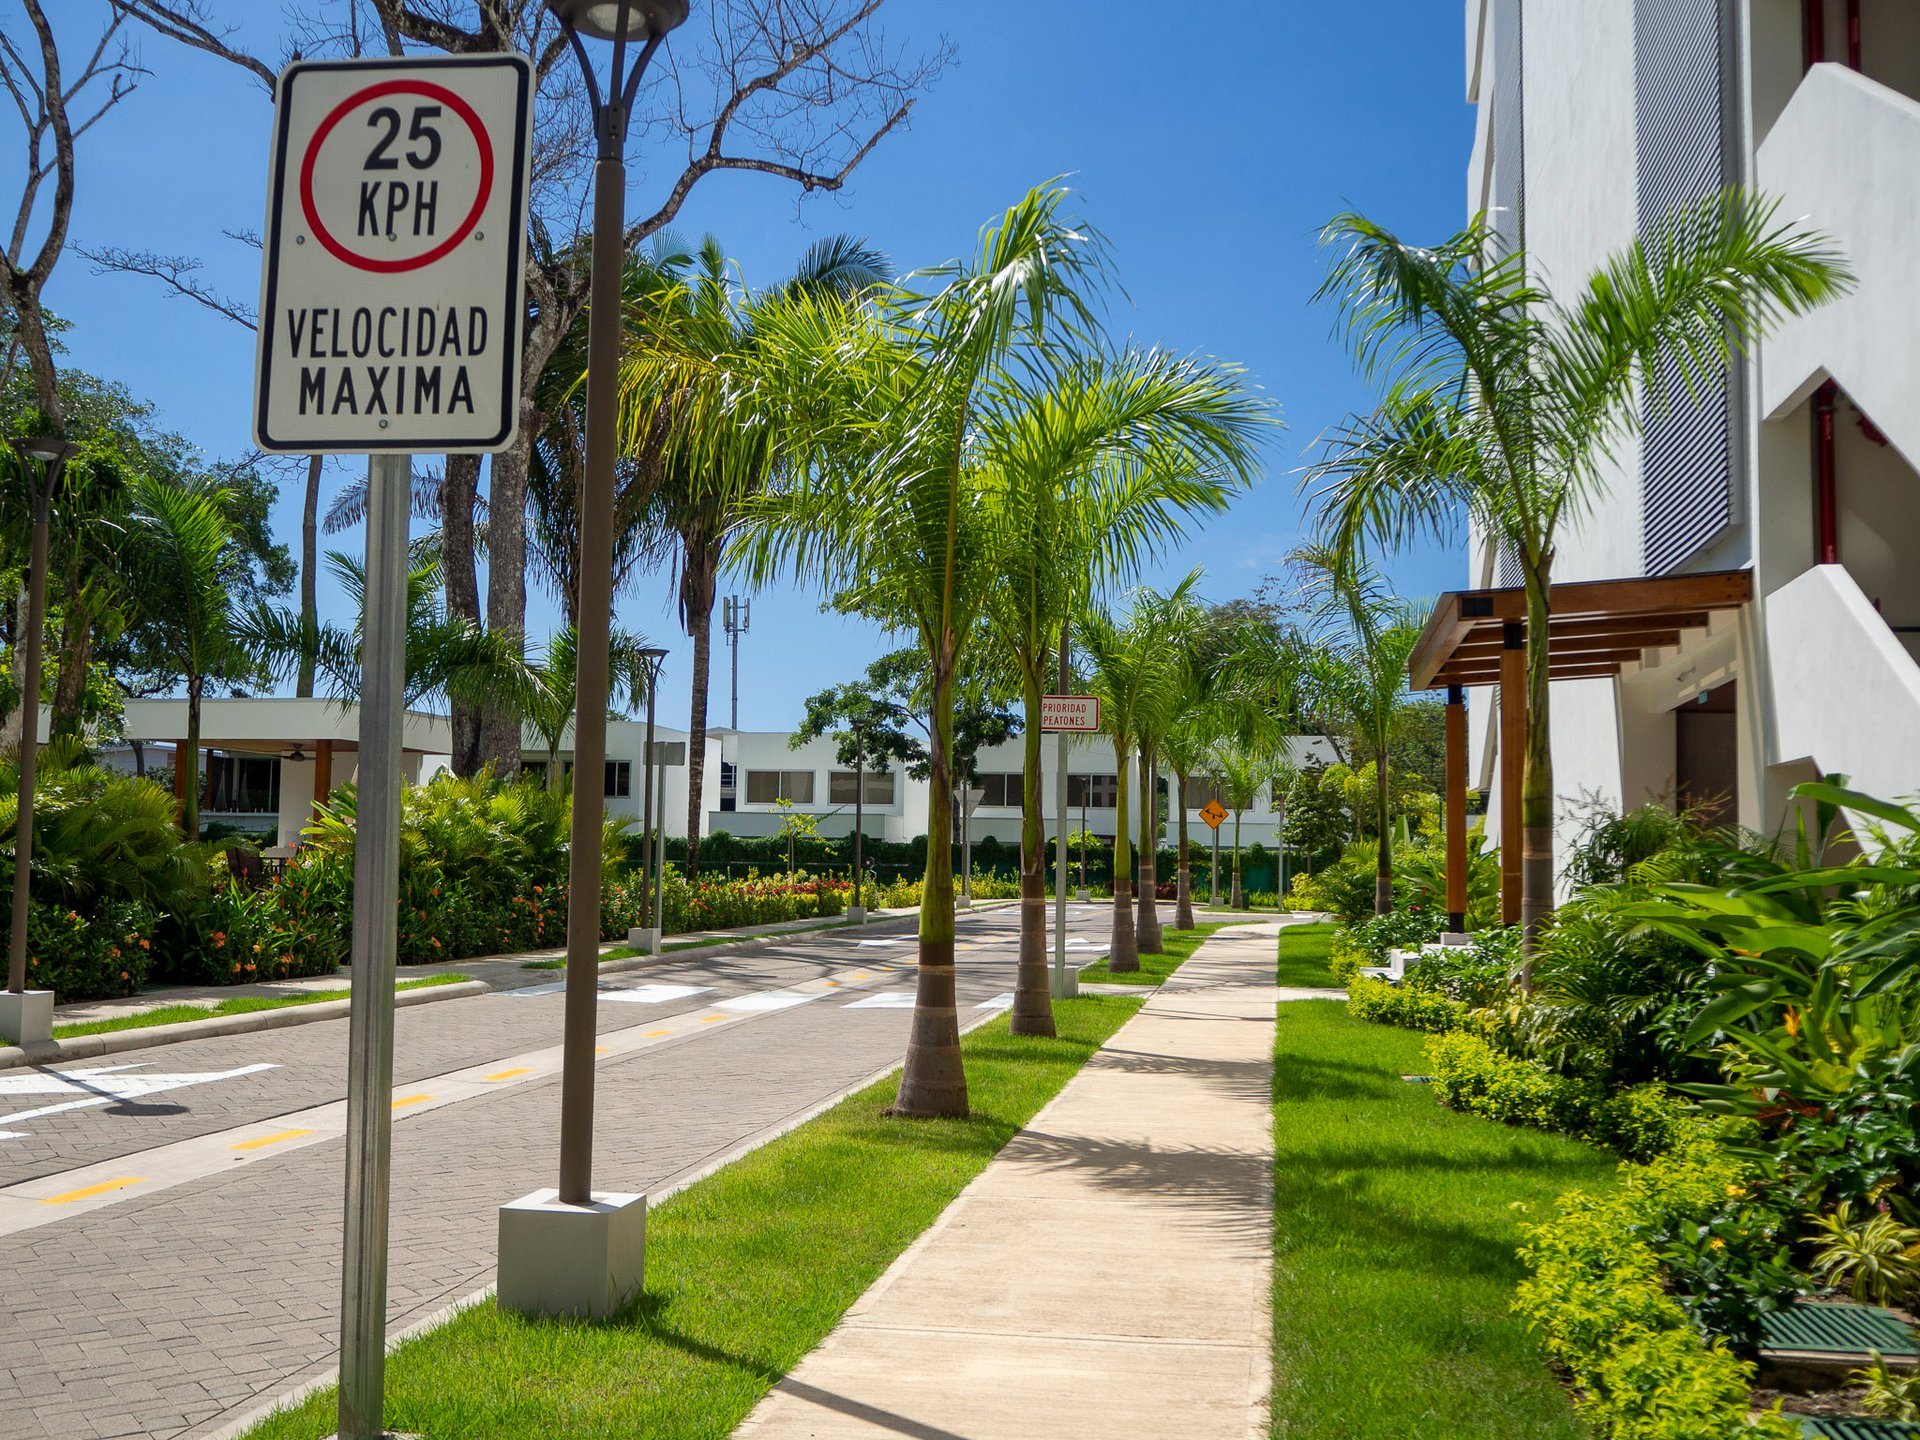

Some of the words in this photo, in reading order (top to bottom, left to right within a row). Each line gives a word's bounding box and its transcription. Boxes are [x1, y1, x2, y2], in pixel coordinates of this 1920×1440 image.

[363, 106, 442, 170] 25
[357, 181, 438, 236] KPH
[288, 307, 488, 358] VELOCIDAD
[299, 366, 475, 415] MAXIMA
[1043, 703, 1087, 713] PRIORIDAD
[1043, 715, 1085, 726] PEATONES
